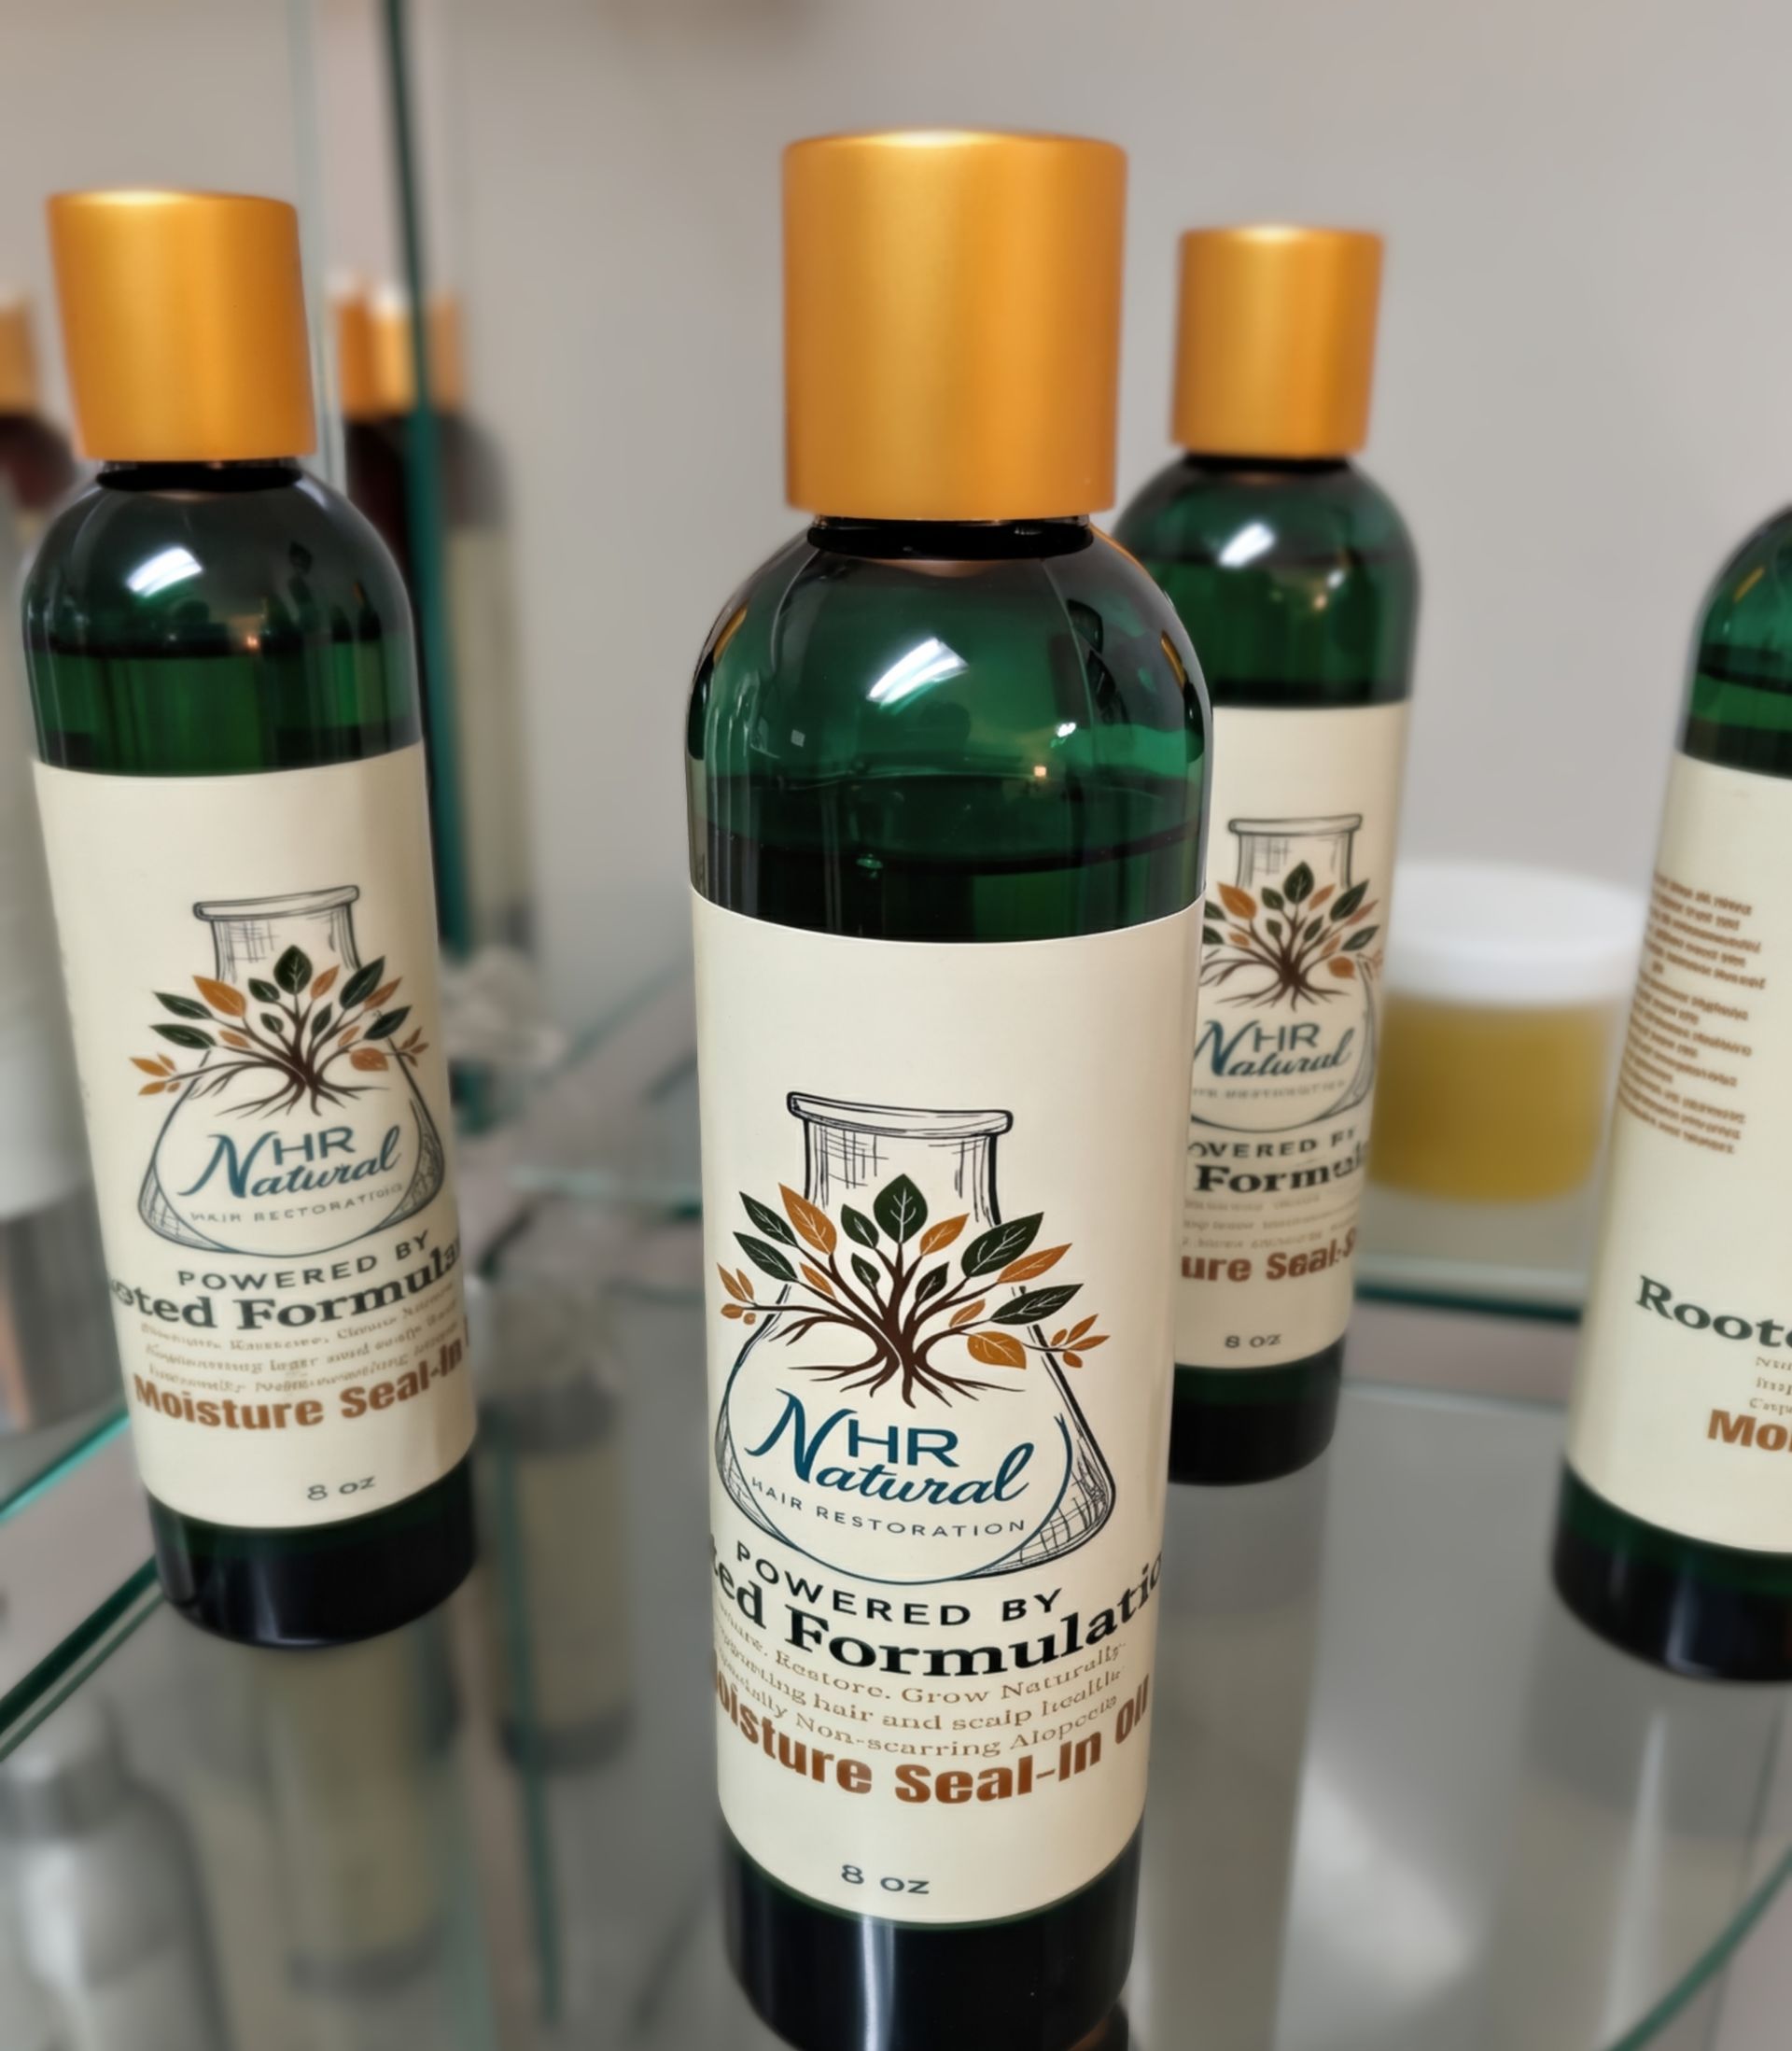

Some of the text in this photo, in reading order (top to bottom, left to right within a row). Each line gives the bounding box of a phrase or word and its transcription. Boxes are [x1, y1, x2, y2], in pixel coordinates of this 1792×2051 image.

[177, 1229, 428, 1290] POWERED BY
[1636, 1274, 1792, 1348] Root
[133, 1373, 324, 1430] Moisture
[1707, 1409, 1792, 1454] Mo
[307, 1475, 377, 1501] 8 oz
[751, 1476, 1025, 1538] HAIR RESTORATION
[735, 1540, 1062, 1626] POWERED BY
[814, 1693, 875, 1722] hair
[882, 1714, 942, 1732] and
[951, 1707, 1032, 1733] scalp
[901, 1687, 989, 1705] Grow
[795, 1712, 1001, 1758] Non-scarring
[893, 1731, 1102, 1805] Seal-In
[840, 1863, 930, 1895] 8 oz
